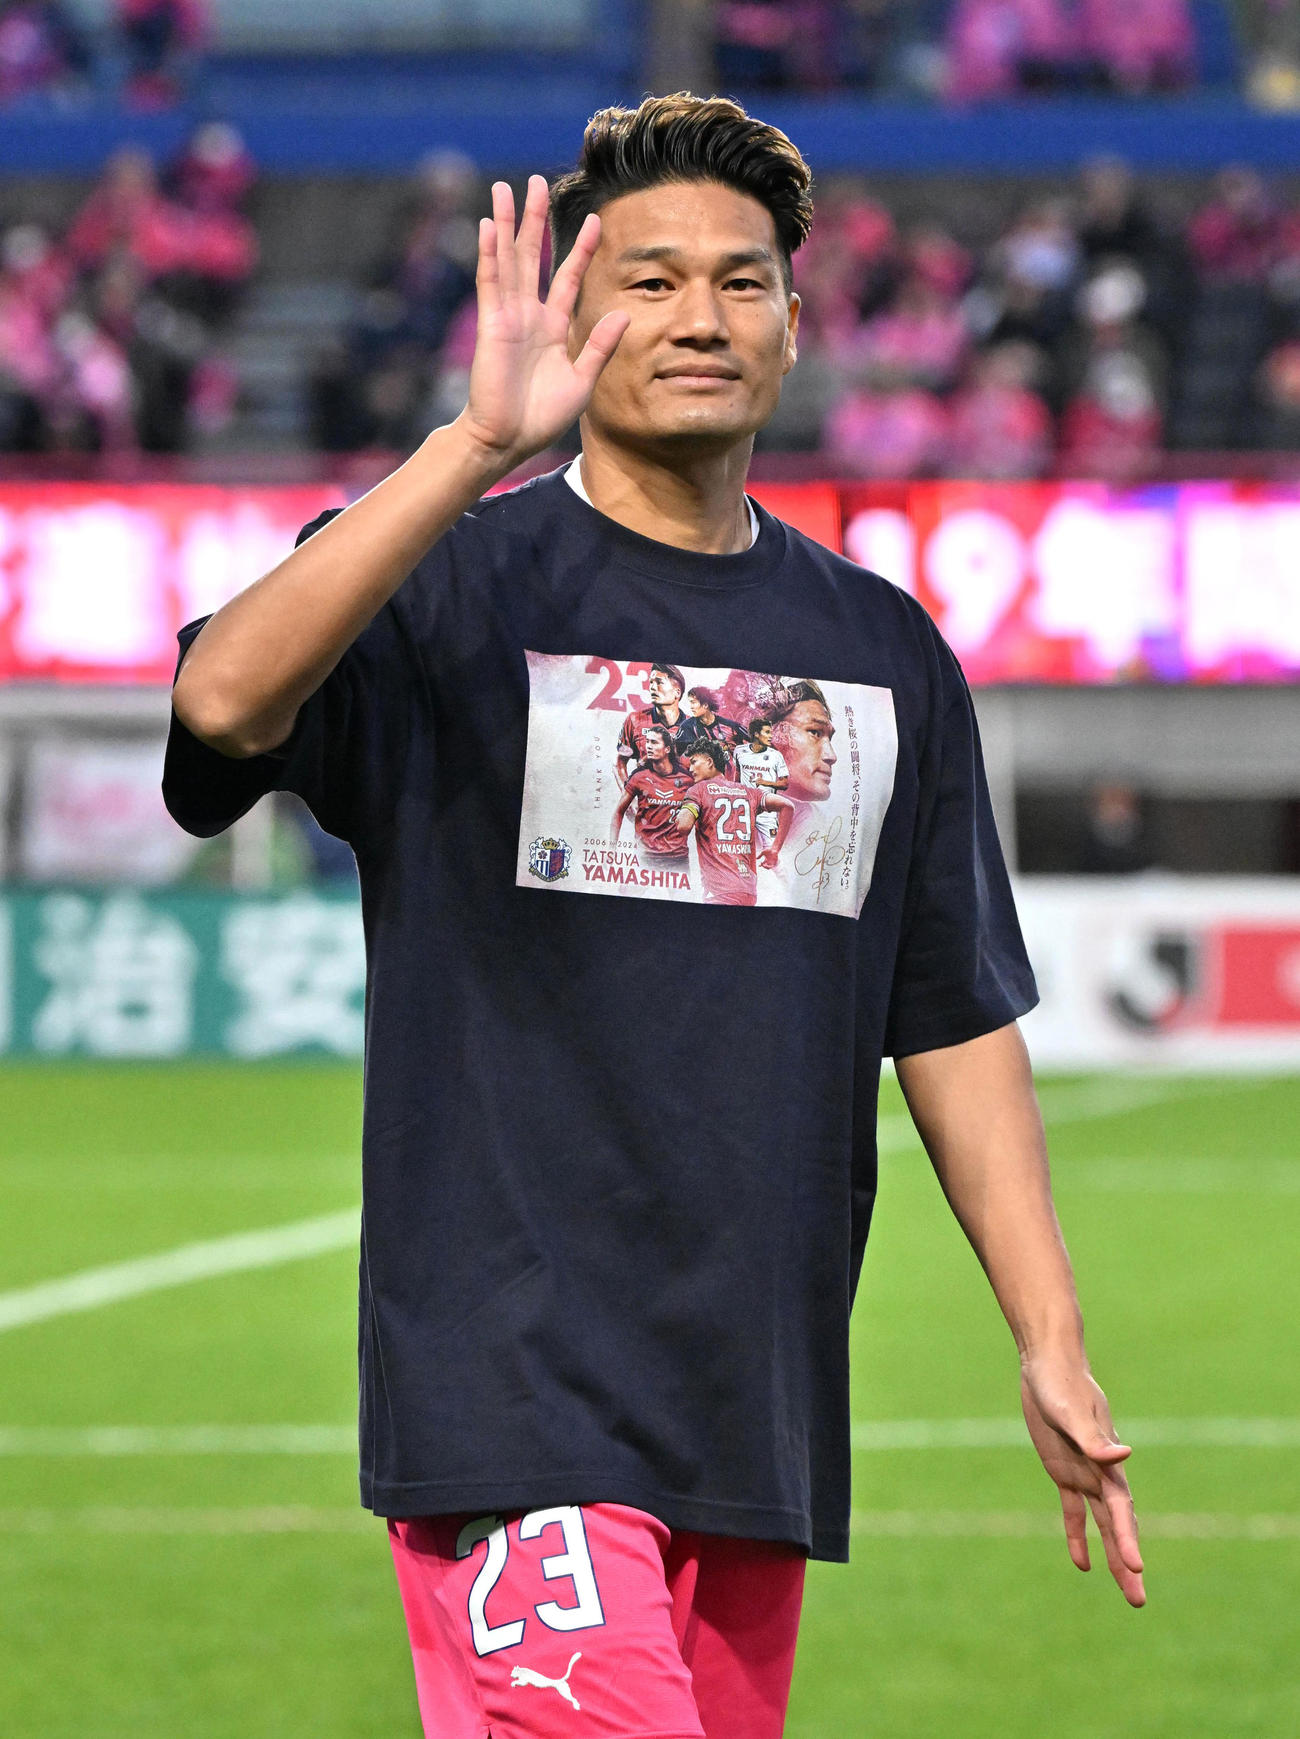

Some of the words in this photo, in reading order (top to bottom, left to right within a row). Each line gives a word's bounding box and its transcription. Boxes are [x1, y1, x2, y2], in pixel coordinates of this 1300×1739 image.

[585, 656, 655, 712] 23
[714, 797, 752, 841] 23
[583, 849, 640, 867] TATSUYA
[584, 838, 607, 846] 2006
[582, 864, 691, 890] YAMASHITA
[0, 892, 366, 1057] 治安
[455, 1505, 606, 1658] 23
